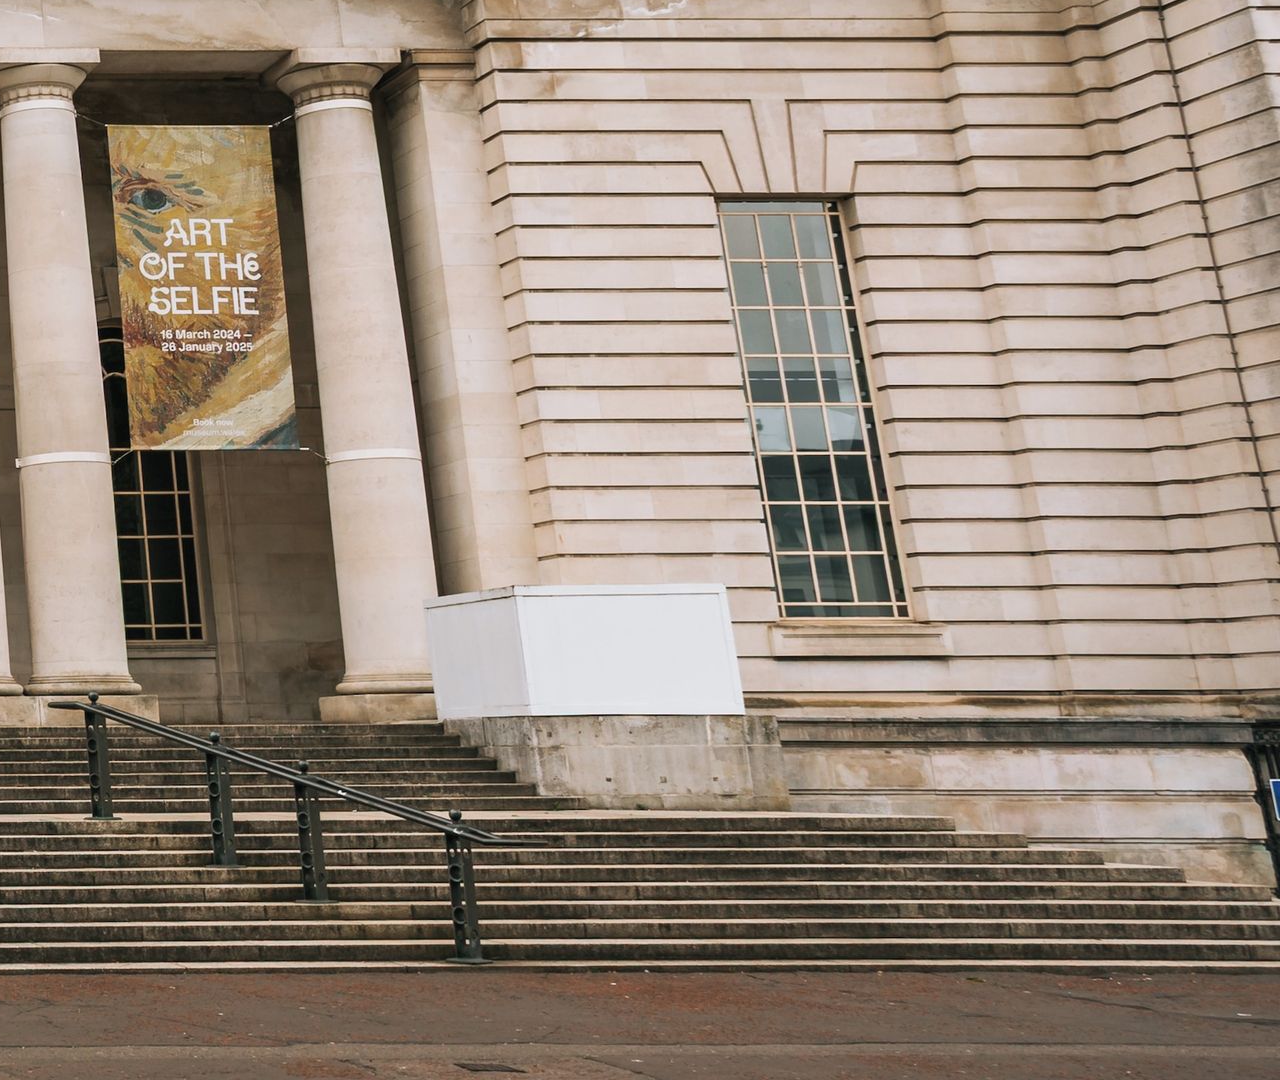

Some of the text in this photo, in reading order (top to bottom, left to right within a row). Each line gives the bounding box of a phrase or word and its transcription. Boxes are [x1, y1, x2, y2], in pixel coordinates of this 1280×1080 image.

[163, 218, 234, 247] ART
[139, 251, 262, 281] OF THE
[148, 286, 260, 315] SELFIE
[160, 330, 173, 340] 16
[175, 330, 210, 340] March
[213, 330, 241, 340] 2024
[161, 342, 254, 353] 26 January 2025
[192, 418, 214, 426] Book
